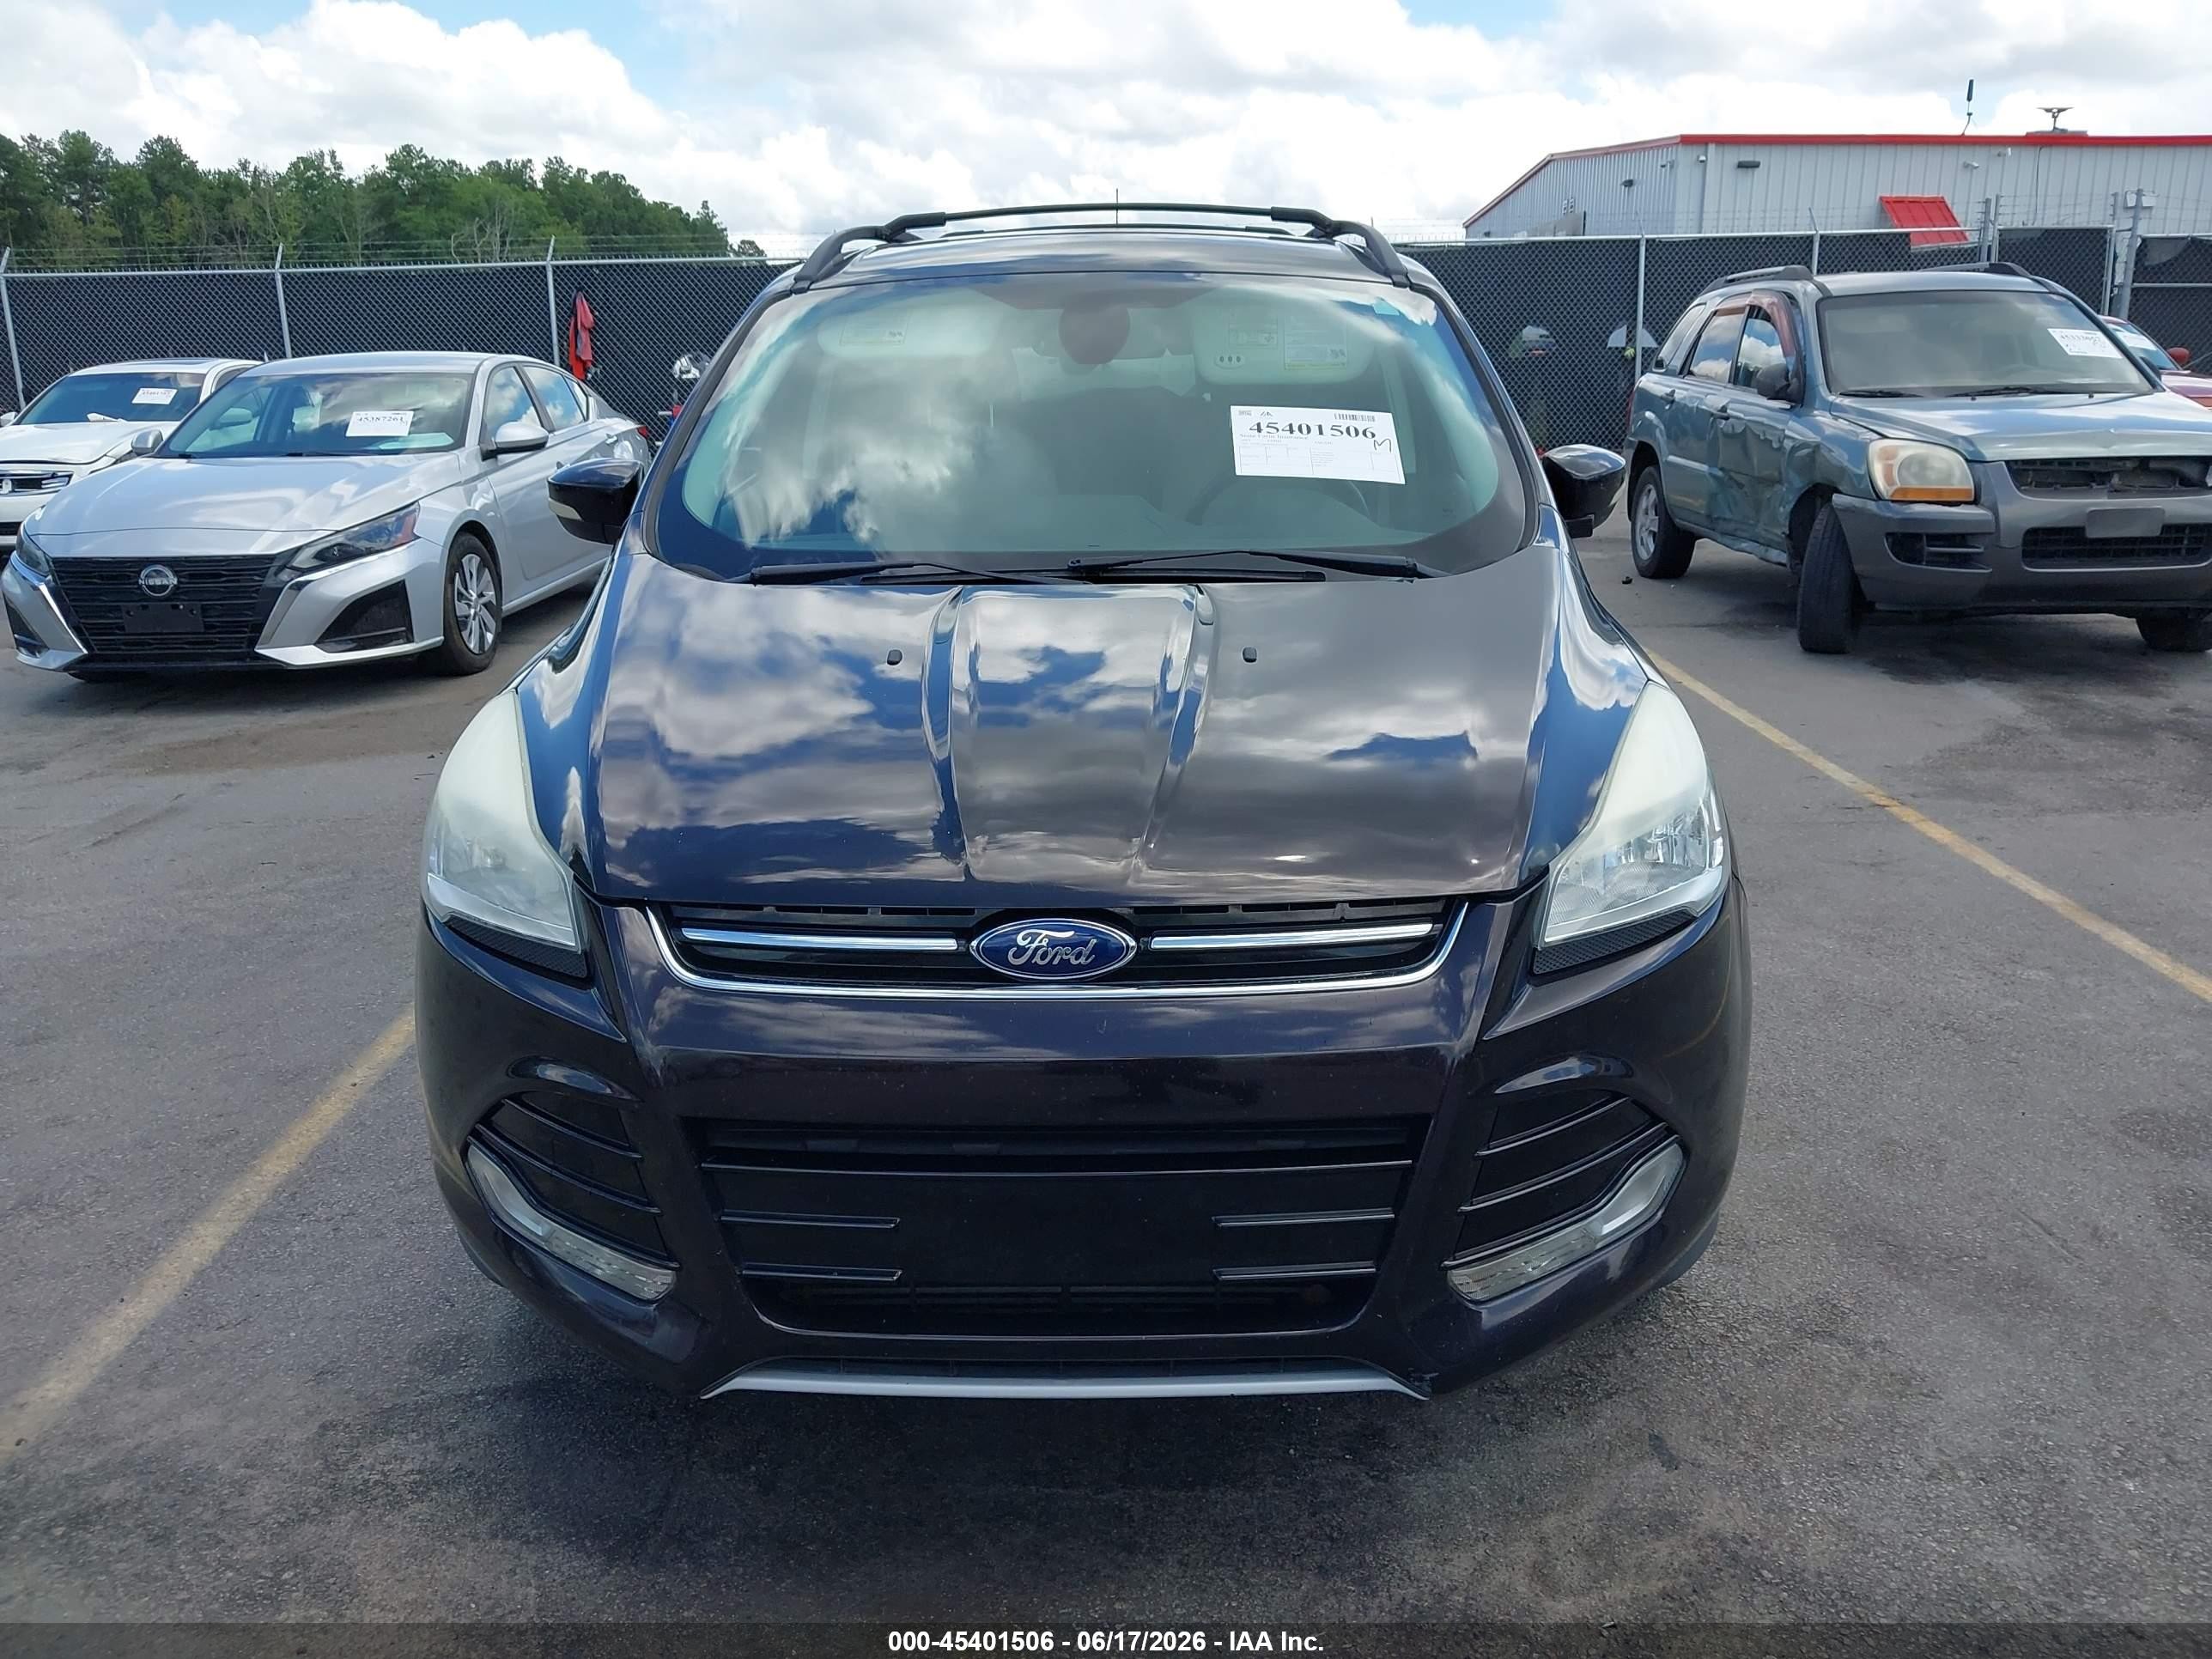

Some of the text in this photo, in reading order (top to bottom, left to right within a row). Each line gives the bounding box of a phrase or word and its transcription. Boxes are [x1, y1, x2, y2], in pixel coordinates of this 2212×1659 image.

[1249, 421, 1376, 440] 45401506
[138, 577, 178, 586] NISSAN
[1007, 928, 1097, 966] Ford
